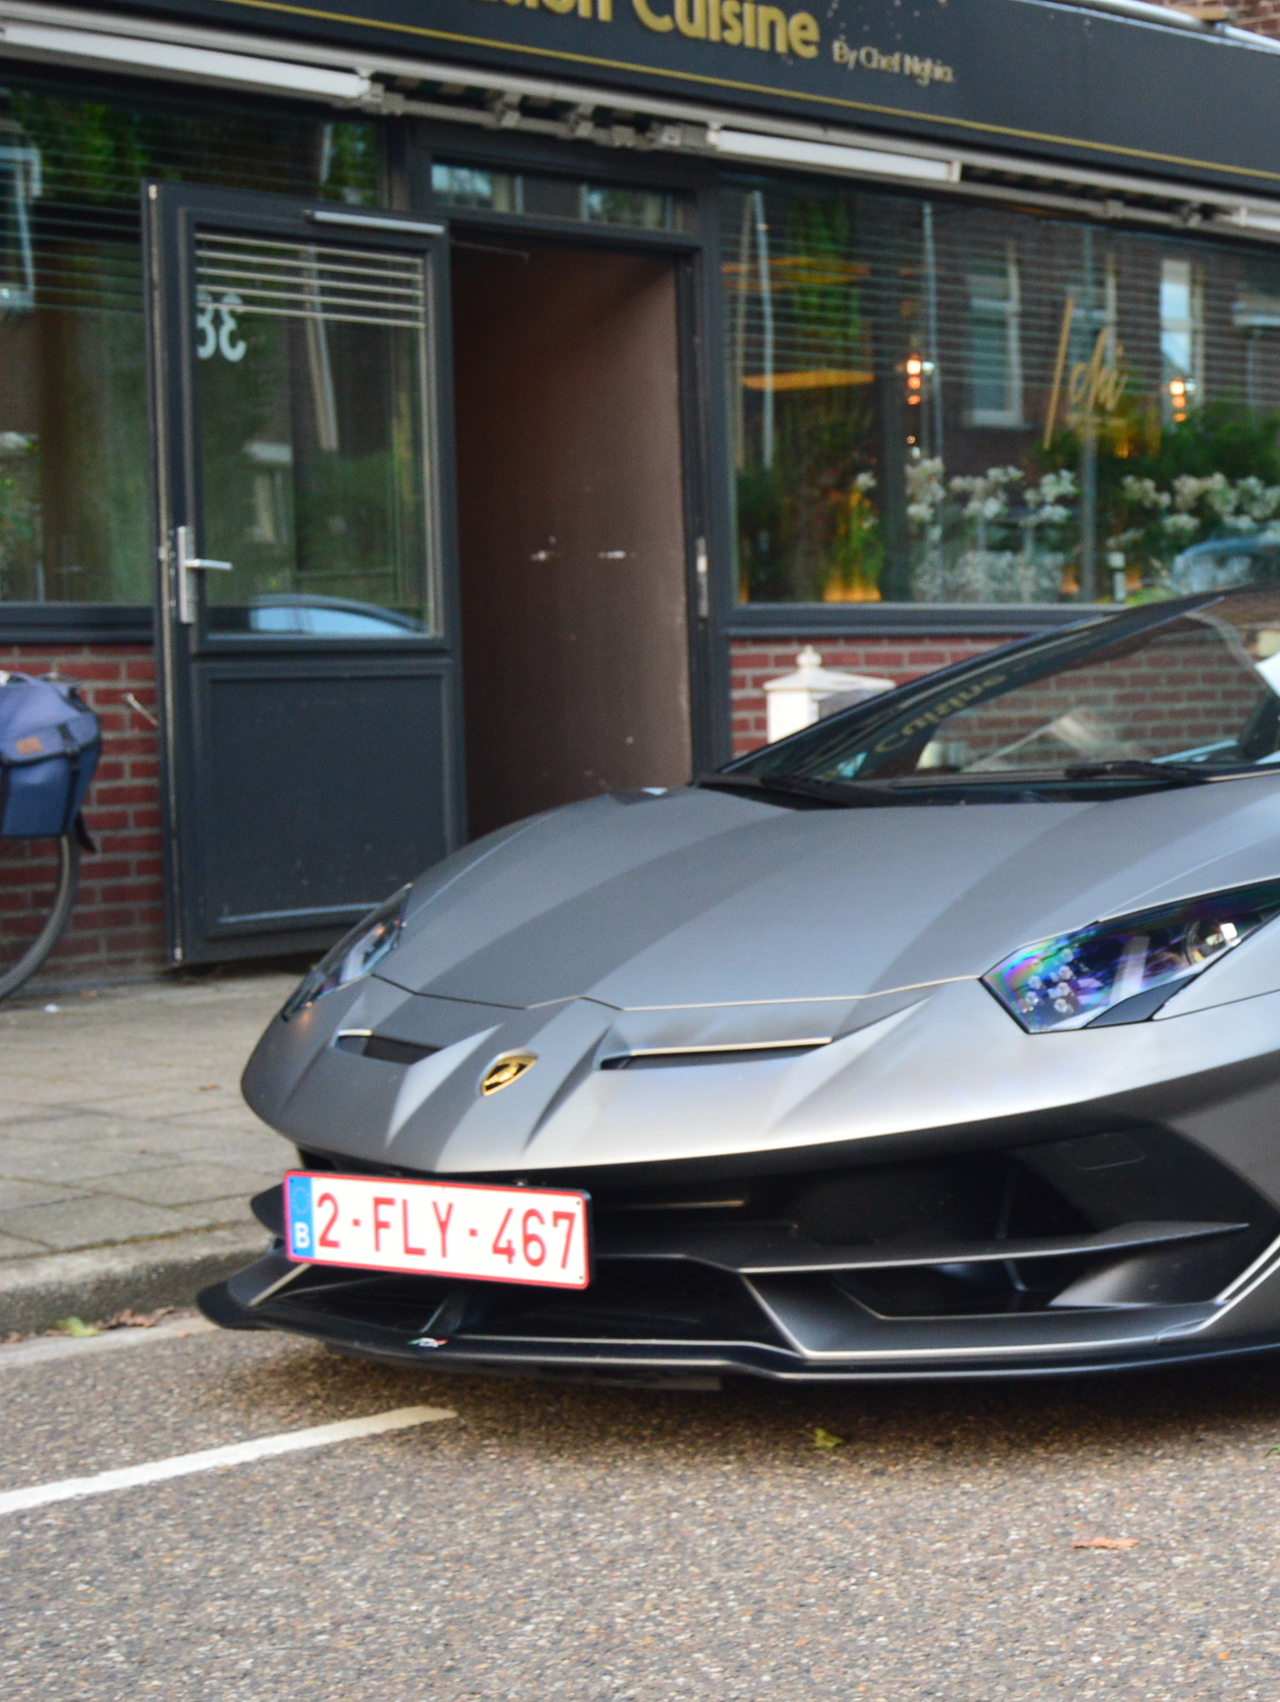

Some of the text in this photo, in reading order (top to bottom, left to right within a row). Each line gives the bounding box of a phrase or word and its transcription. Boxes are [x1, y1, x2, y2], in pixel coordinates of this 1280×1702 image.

[832, 39, 858, 70] By
[859, 46, 902, 73] Chef
[294, 1221, 311, 1249] B
